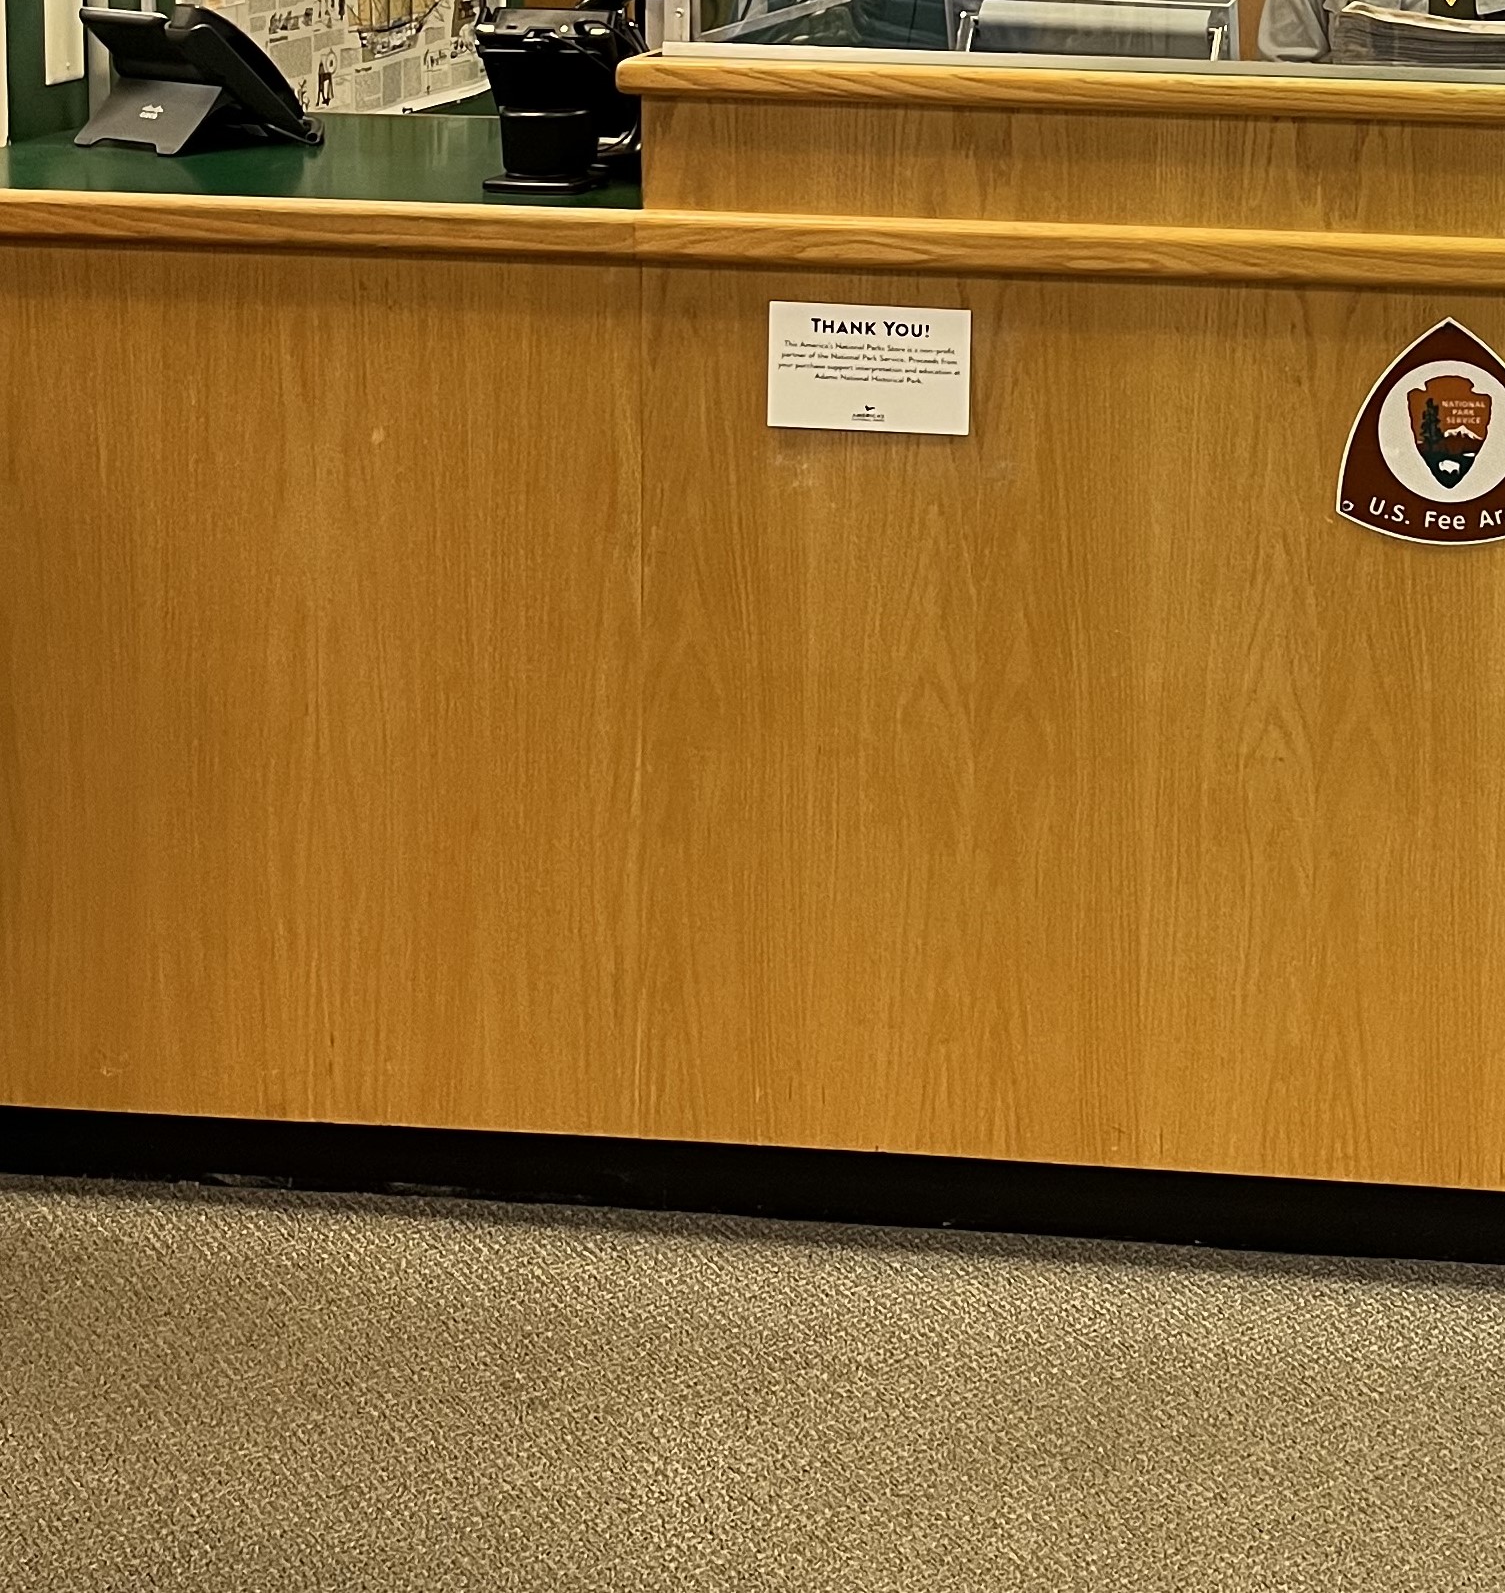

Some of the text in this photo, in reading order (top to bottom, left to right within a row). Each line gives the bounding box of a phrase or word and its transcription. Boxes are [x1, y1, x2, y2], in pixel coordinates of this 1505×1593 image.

[811, 317, 930, 338] THANK YOU!
[800, 341, 833, 350] America's
[887, 345, 906, 353] Store
[919, 347, 955, 355] non-profit
[808, 351, 816, 359] of
[830, 353, 860, 361] National
[862, 354, 877, 362] Park
[908, 356, 939, 364] Proceeds
[940, 357, 958, 365] from
[827, 364, 853, 372] support
[855, 365, 902, 373] interpretation
[871, 375, 904, 383] Historical
[1441, 400, 1486, 408] NATIONAL
[1446, 416, 1482, 424] SERVICE
[1369, 496, 1410, 525] U.S.
[1424, 511, 1466, 530] Fee
